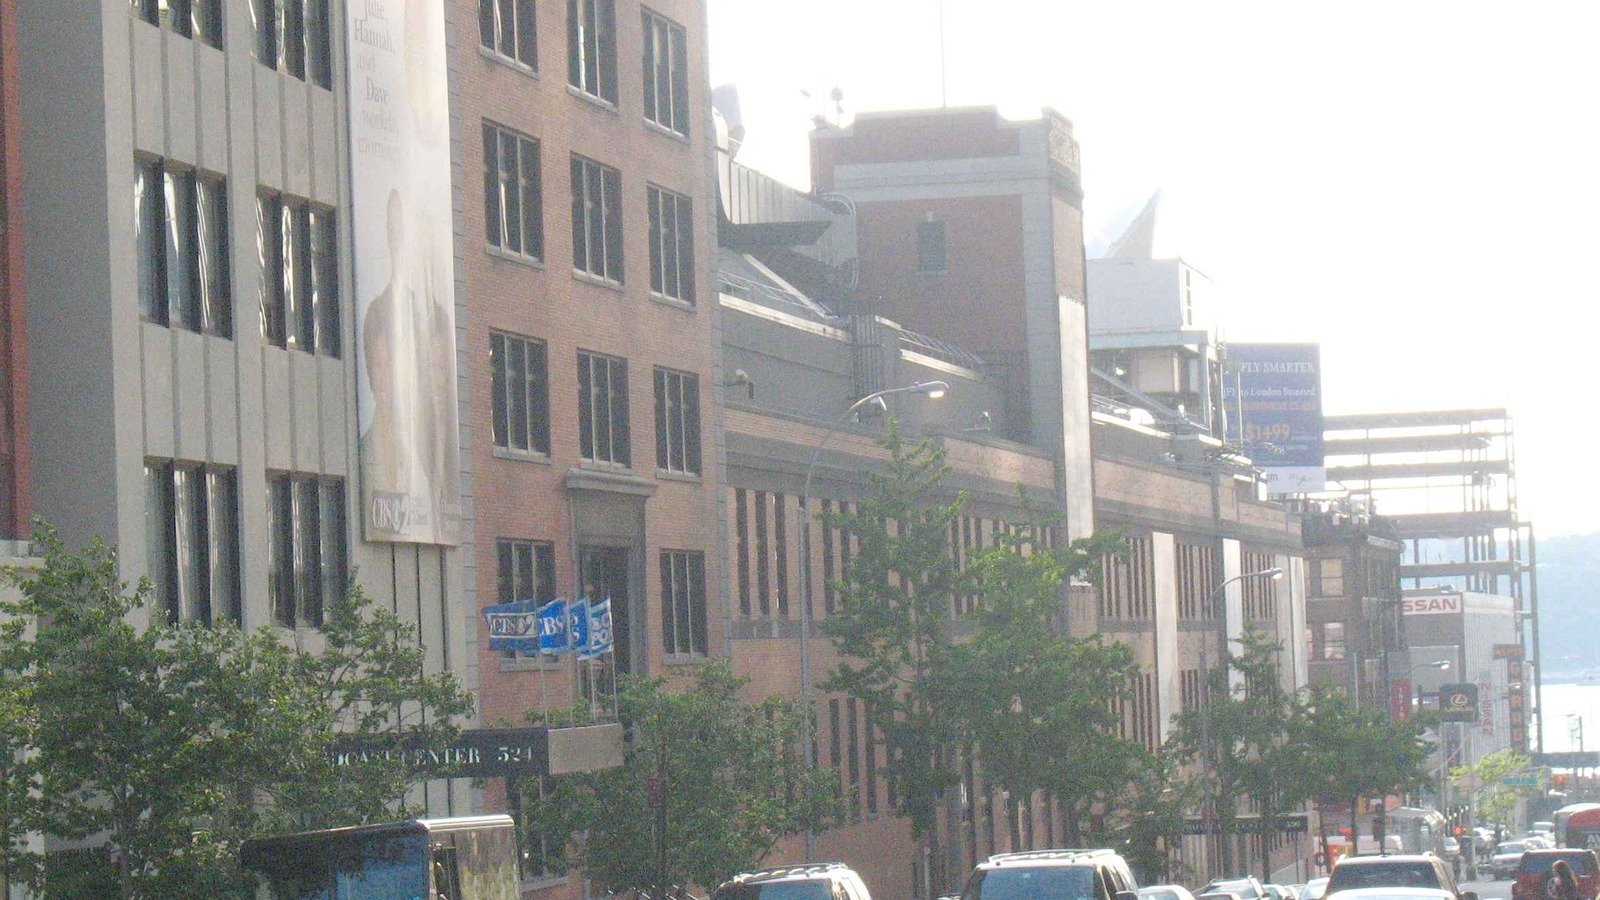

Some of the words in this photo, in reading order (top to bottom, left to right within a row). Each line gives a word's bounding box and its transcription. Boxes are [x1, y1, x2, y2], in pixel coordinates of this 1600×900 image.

[1241, 362, 1260, 373] FLY
[1263, 362, 1315, 373] SMARTER
[1251, 386, 1282, 397] London
[1245, 422, 1291, 440] $1499
[1402, 598, 1457, 612] SSAN
[401, 747, 481, 767] CENTER
